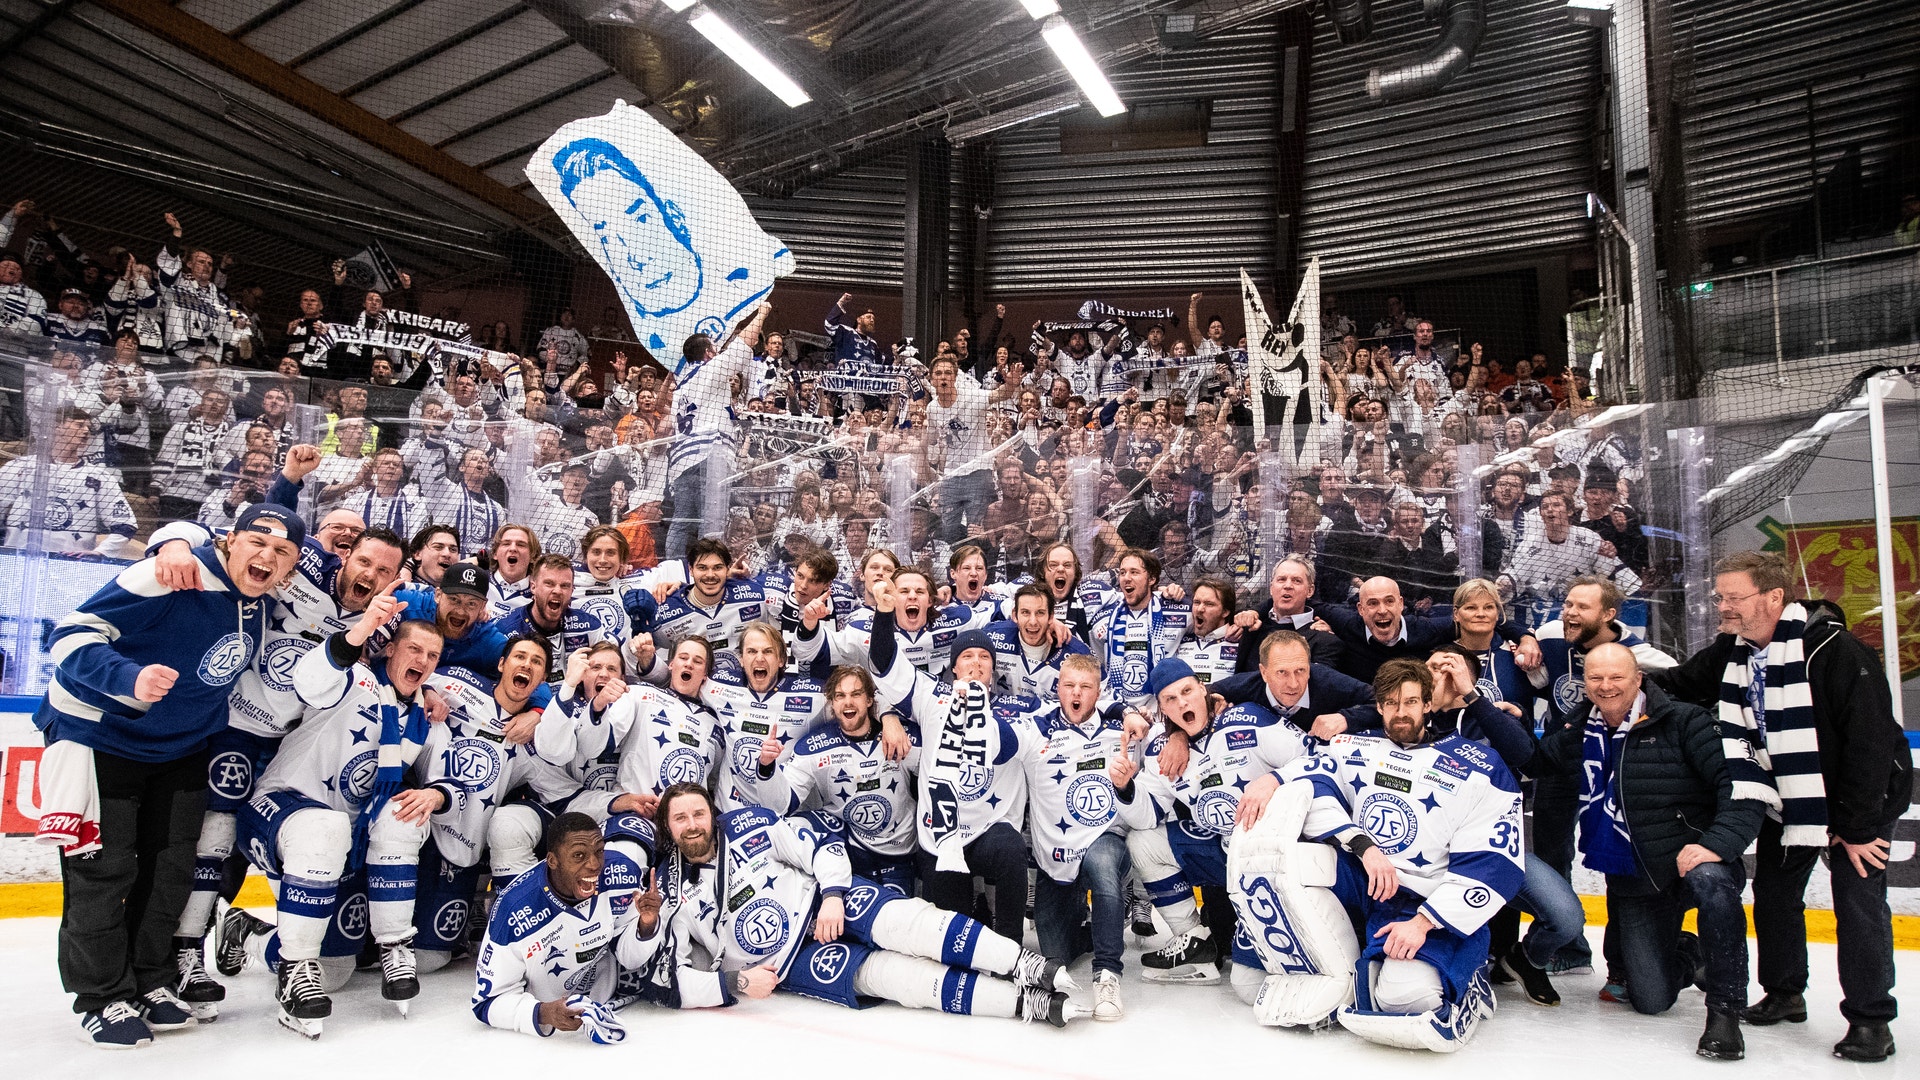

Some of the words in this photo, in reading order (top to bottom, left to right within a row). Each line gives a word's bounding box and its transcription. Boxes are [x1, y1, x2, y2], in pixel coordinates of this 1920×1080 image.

[301, 546, 323, 568] clas
[298, 559, 324, 585] hlson
[733, 584, 751, 593] clas
[765, 582, 788, 590] ohlso
[734, 592, 762, 600] ohlson
[448, 669, 483, 688] ohlson
[791, 683, 821, 692] ohlson
[233, 692, 275, 721] Dalarnas
[998, 697, 1030, 707] ohlson
[1222, 714, 1258, 725] ohlson
[806, 732, 827, 745] clas
[808, 736, 842, 752] ohlson
[1049, 736, 1070, 744] ergkvist
[1435, 735, 1456, 745] TEGERA
[1461, 743, 1487, 760] clas
[341, 752, 373, 782] LEKSANDS
[441, 750, 461, 777] 10
[1225, 756, 1248, 766] dalakraft
[1454, 748, 1494, 772] ohlson
[1386, 763, 1412, 774] TEGERA
[1435, 761, 1468, 777] LEKSANDS
[1377, 774, 1409, 786] GRÖNSAKS
[1423, 773, 1456, 790] dalakraft
[731, 810, 754, 826] clas
[734, 816, 769, 833] ohlson
[1078, 815, 1111, 826] ISHOCKEY
[1488, 821, 1520, 858] 33
[730, 848, 748, 869] A
[603, 864, 628, 876] clas
[547, 892, 567, 910] TEGERA
[687, 888, 702, 900] Insjön
[1470, 890, 1487, 904] 19
[576, 901, 590, 910] KLC
[739, 899, 788, 923] IDROTTSFORENING
[508, 905, 533, 926] clas
[513, 907, 551, 937] ohlson
[581, 934, 607, 947] TEGERA
[735, 920, 756, 954] LEKSANDS
